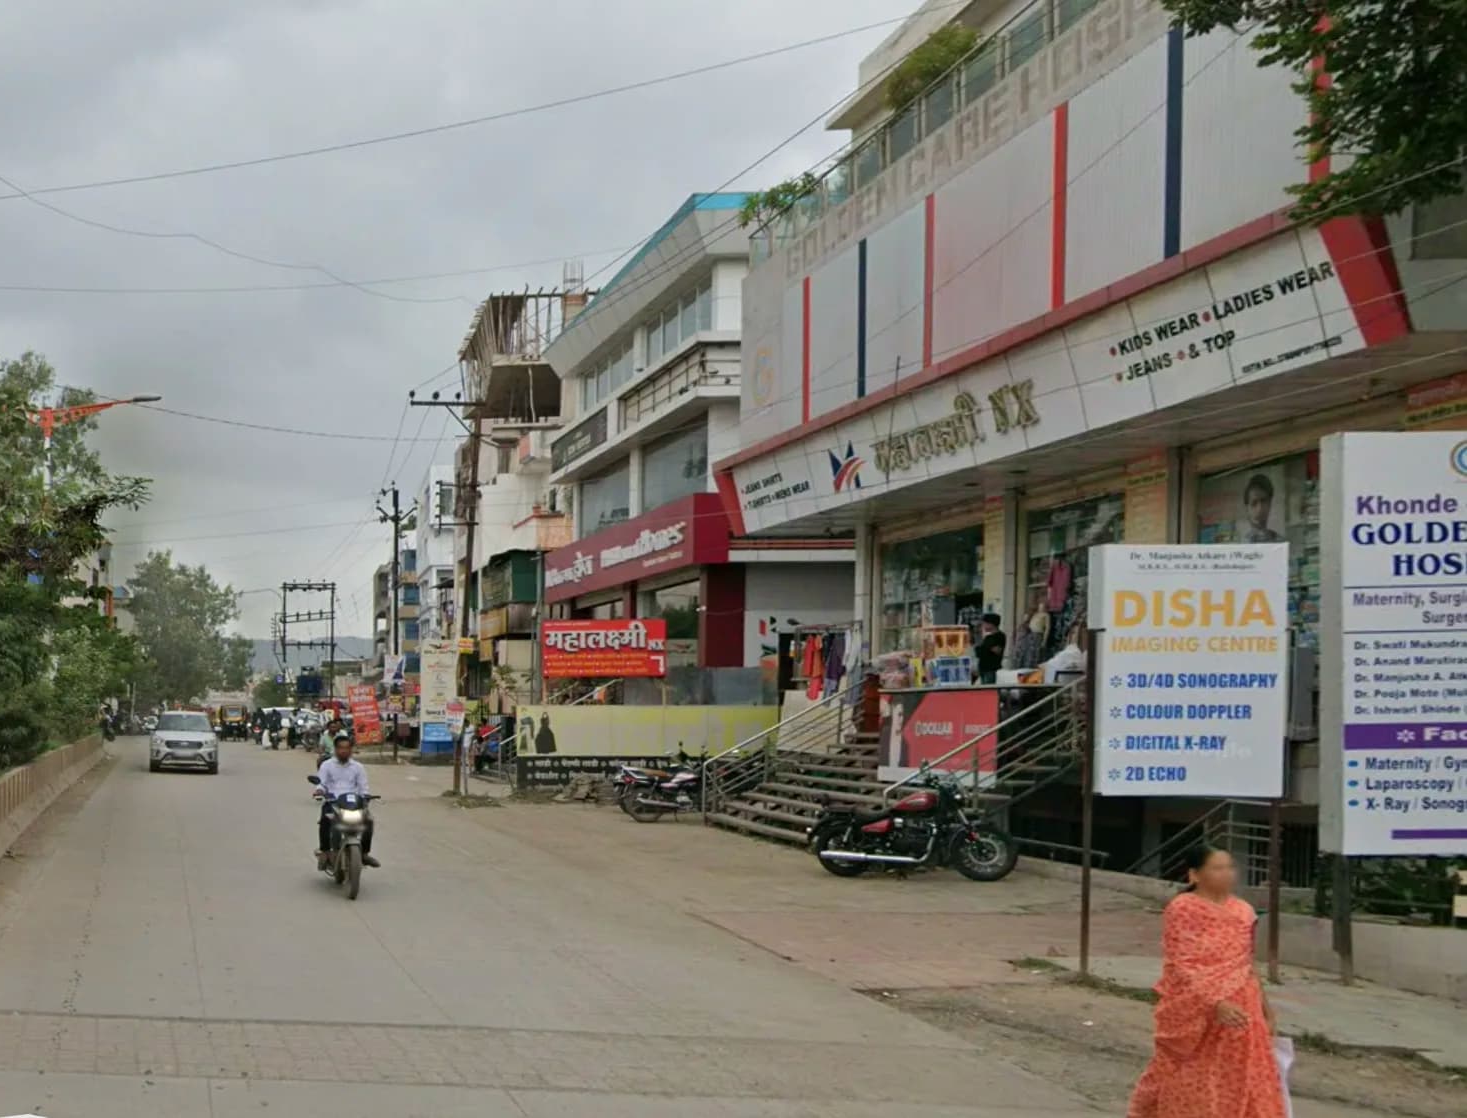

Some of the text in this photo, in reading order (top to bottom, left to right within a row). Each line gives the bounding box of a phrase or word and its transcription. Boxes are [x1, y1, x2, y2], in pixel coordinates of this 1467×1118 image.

[1118, 260, 1335, 356] KIDS WEAR LADIES WEAR
[1127, 330, 1237, 382] JEANS & TOP
[1356, 494, 1459, 516] Khonde
[1393, 552, 1467, 577] HOS
[1353, 592, 1425, 608] Maternity,
[1112, 589, 1277, 630] DISHA
[545, 621, 646, 652] महालक्ष्मी
[1112, 636, 1278, 654] IMAGING CENTRE
[1354, 641, 1370, 651] Dr.
[1354, 657, 1370, 667] Dr.
[1127, 673, 1278, 689] 3D/4D SONOGRAPHY
[1354, 673, 1370, 684] Dr.
[1354, 690, 1370, 700] Dr.
[1126, 704, 1252, 720] COLOUR DOPPLER
[1354, 706, 1371, 716] Dr.
[1125, 735, 1181, 751] DIGITAL
[1184, 735, 1226, 751] X-RAY
[1365, 756, 1432, 773] Maternity
[1125, 766, 1186, 781] 2D ECHO
[1366, 777, 1454, 794] Laparoscopy
